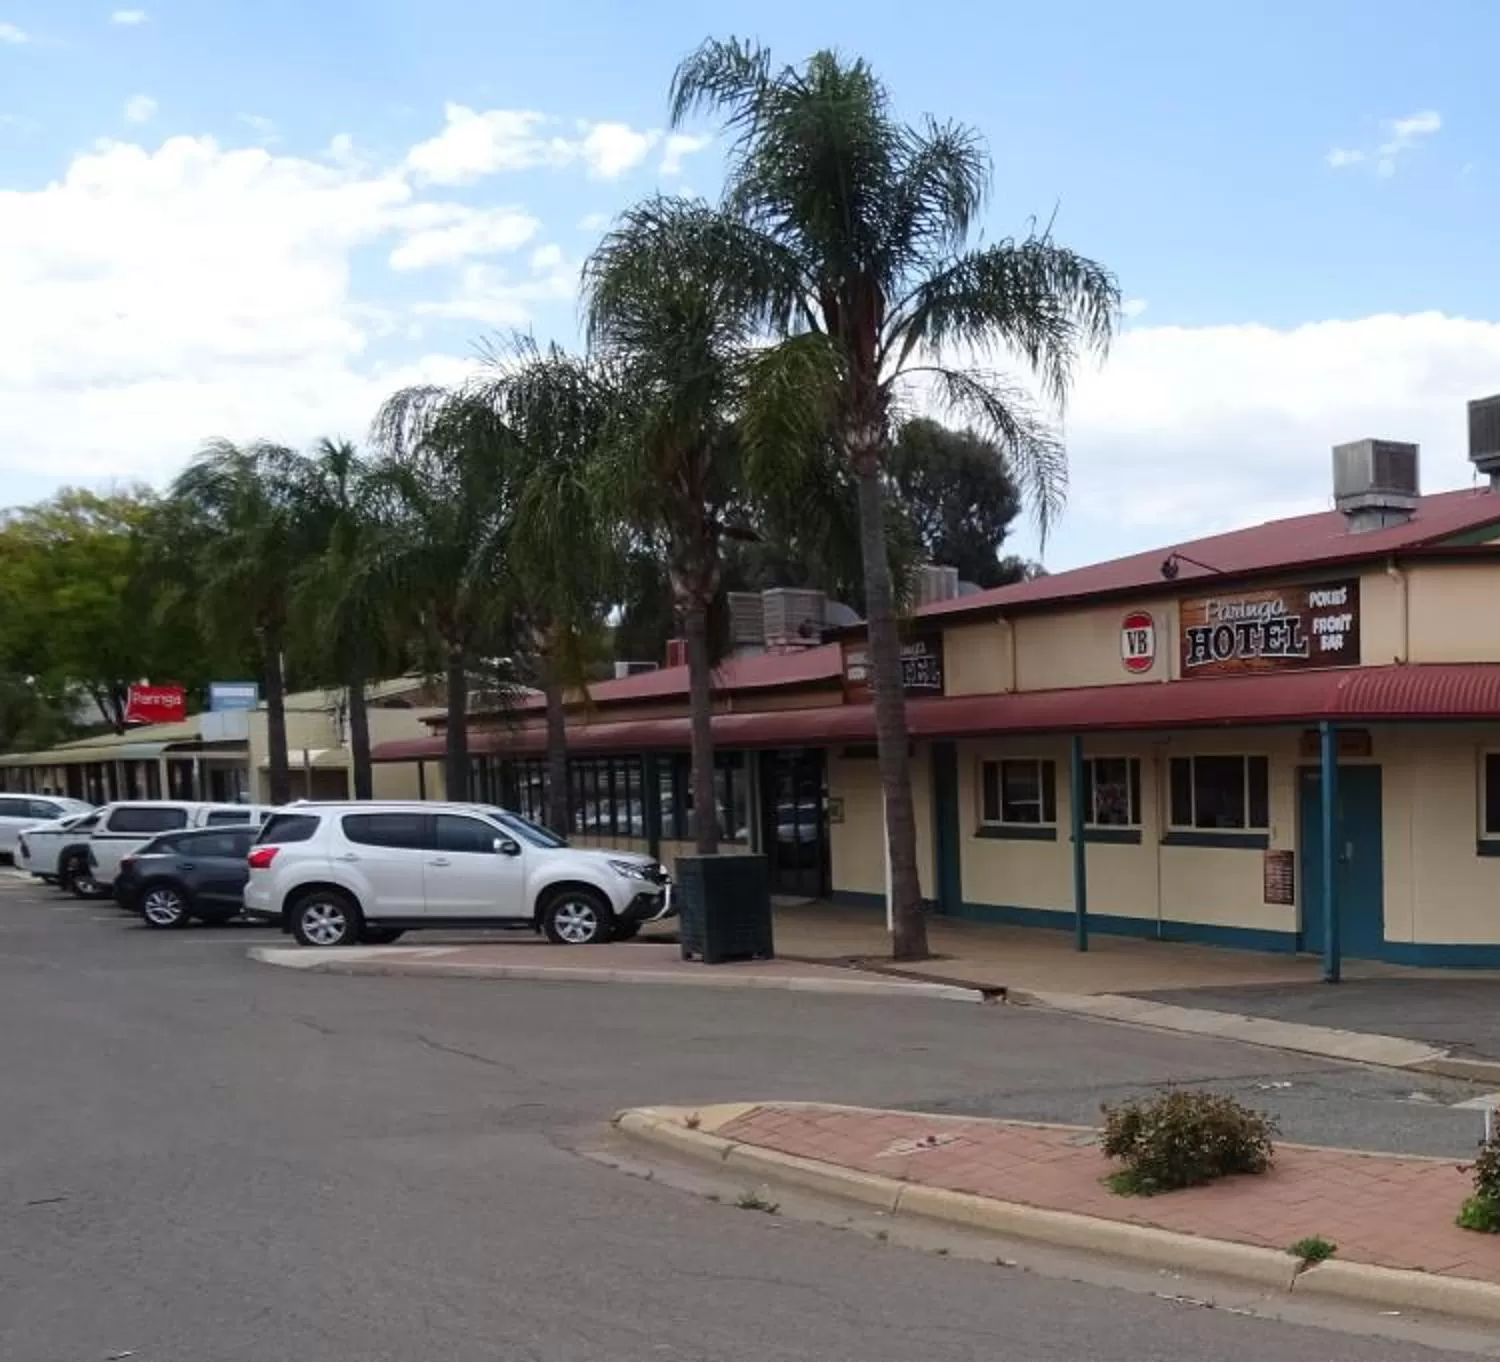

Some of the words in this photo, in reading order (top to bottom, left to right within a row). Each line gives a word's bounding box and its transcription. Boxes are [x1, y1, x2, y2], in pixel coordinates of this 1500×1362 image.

[1313, 614, 1352, 634] FRONT
[1126, 631, 1148, 655] VB
[1186, 616, 1309, 667] HOTEL
